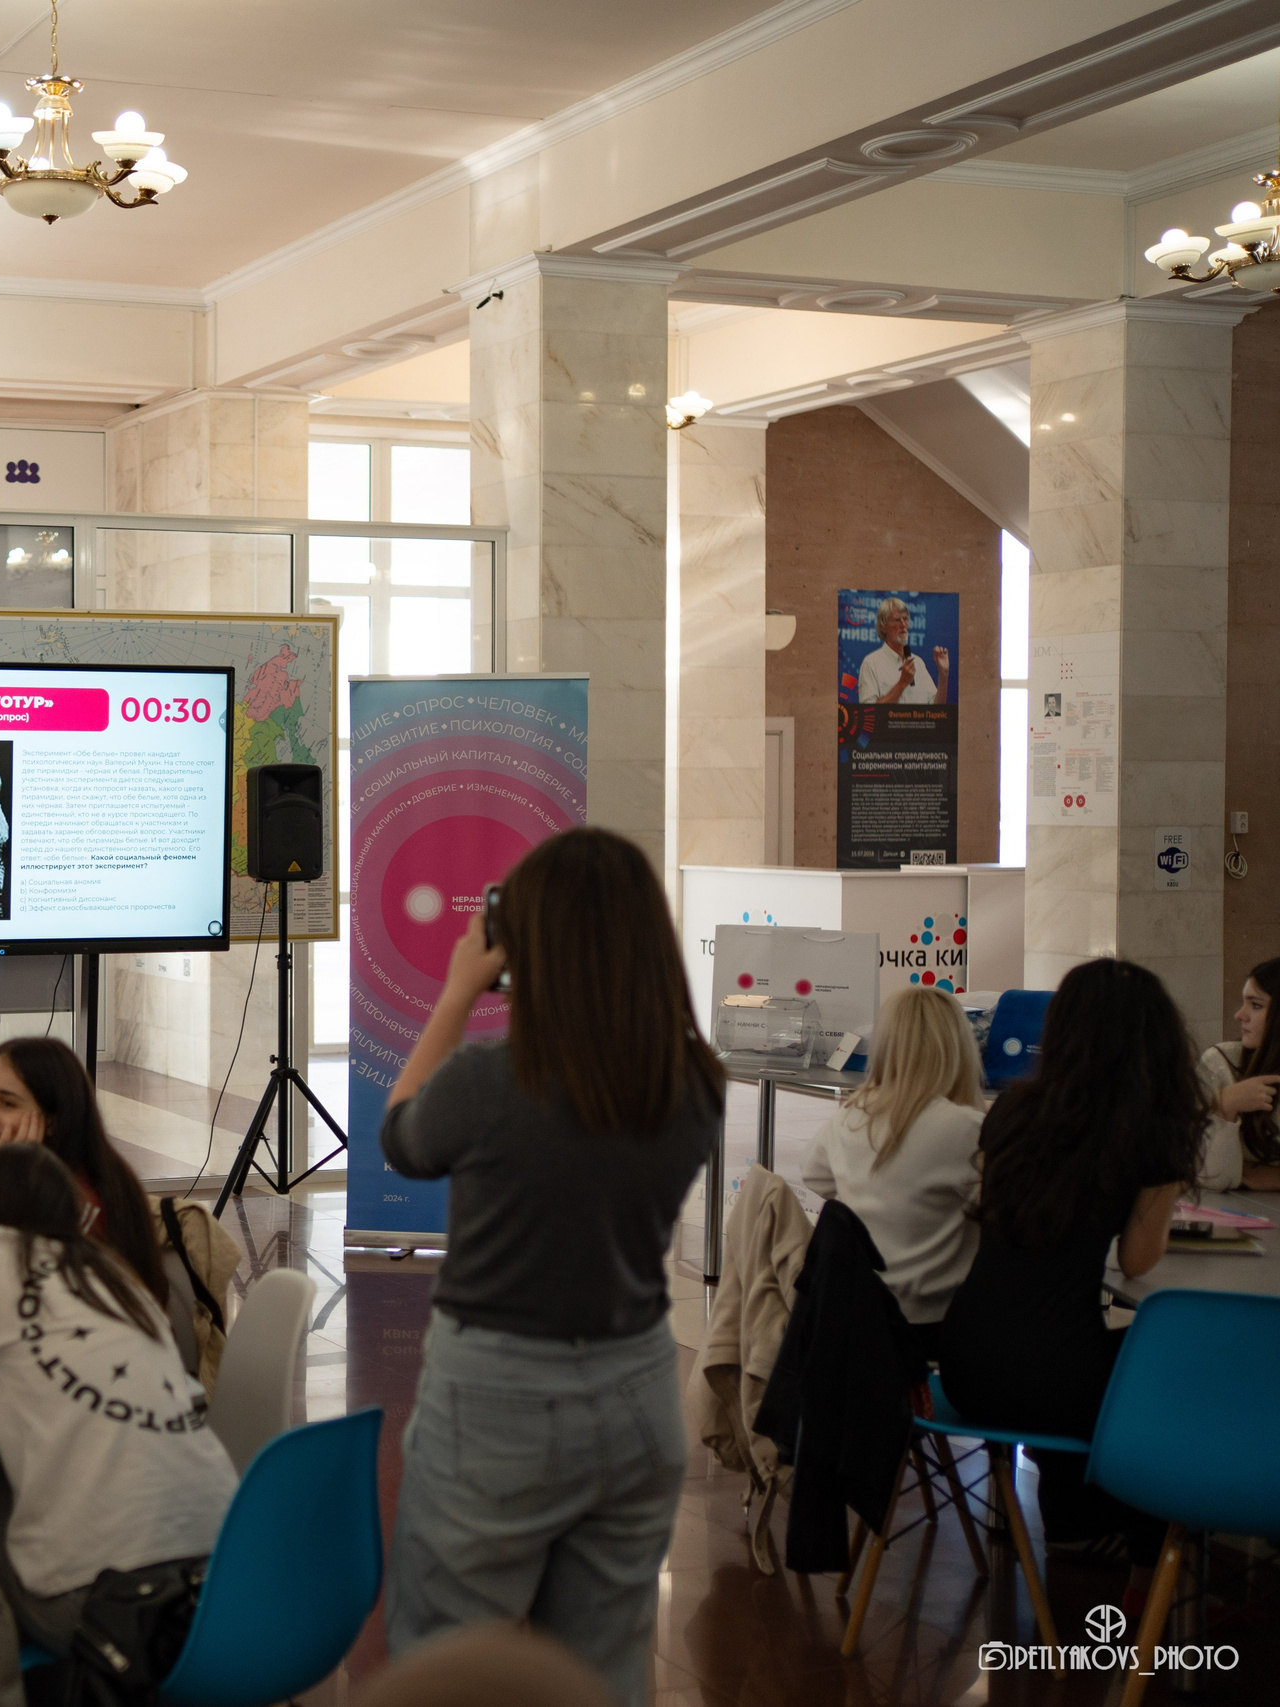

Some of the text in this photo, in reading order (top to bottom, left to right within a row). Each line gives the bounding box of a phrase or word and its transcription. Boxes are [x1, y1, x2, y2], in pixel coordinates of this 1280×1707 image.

[120, 696, 211, 724] 00:30
[402, 695, 557, 727] ОПРОС ЧЕЛОВЕК
[364, 722, 439, 761] РАЗВИТИЕ
[450, 719, 554, 750] ПСИХОЛОГИЯ
[22, 750, 72, 758] Эксперимент
[147, 750, 181, 758] кандидат
[852, 750, 949, 762] Социальная справедливость
[22, 759, 85, 767] психологических
[86, 759, 103, 767] наук
[858, 763, 903, 771] современном
[364, 750, 573, 800] СОЦИАЛЬНЫЙ КАПИТАЛ ДОВЕРИЕ
[66, 794, 81, 802] они
[110, 794, 122, 802] что
[122, 794, 136, 802] обе
[163, 794, 178, 802] хотя
[180, 794, 197, 802] одна
[1163, 835, 1182, 844] FREE
[350, 837, 374, 907] СОЦИАЛЬНЫЙ
[371, 802, 408, 838] КАПИТАЛ
[411, 783, 458, 805] ДОВЕРИЕ
[466, 783, 528, 807] ИЗМЕНЕНИЯ
[90, 854, 114, 862] Какой
[115, 854, 162, 862] социальный
[163, 854, 197, 862] феномен
[29, 887, 77, 895] Конформизм
[28, 896, 117, 904] Когнитивный диссонанс
[351, 914, 370, 957] МНЕНИЕ
[370, 961, 406, 999] ЧЕЛОВЕК
[383, 1194, 403, 1202] 2024
